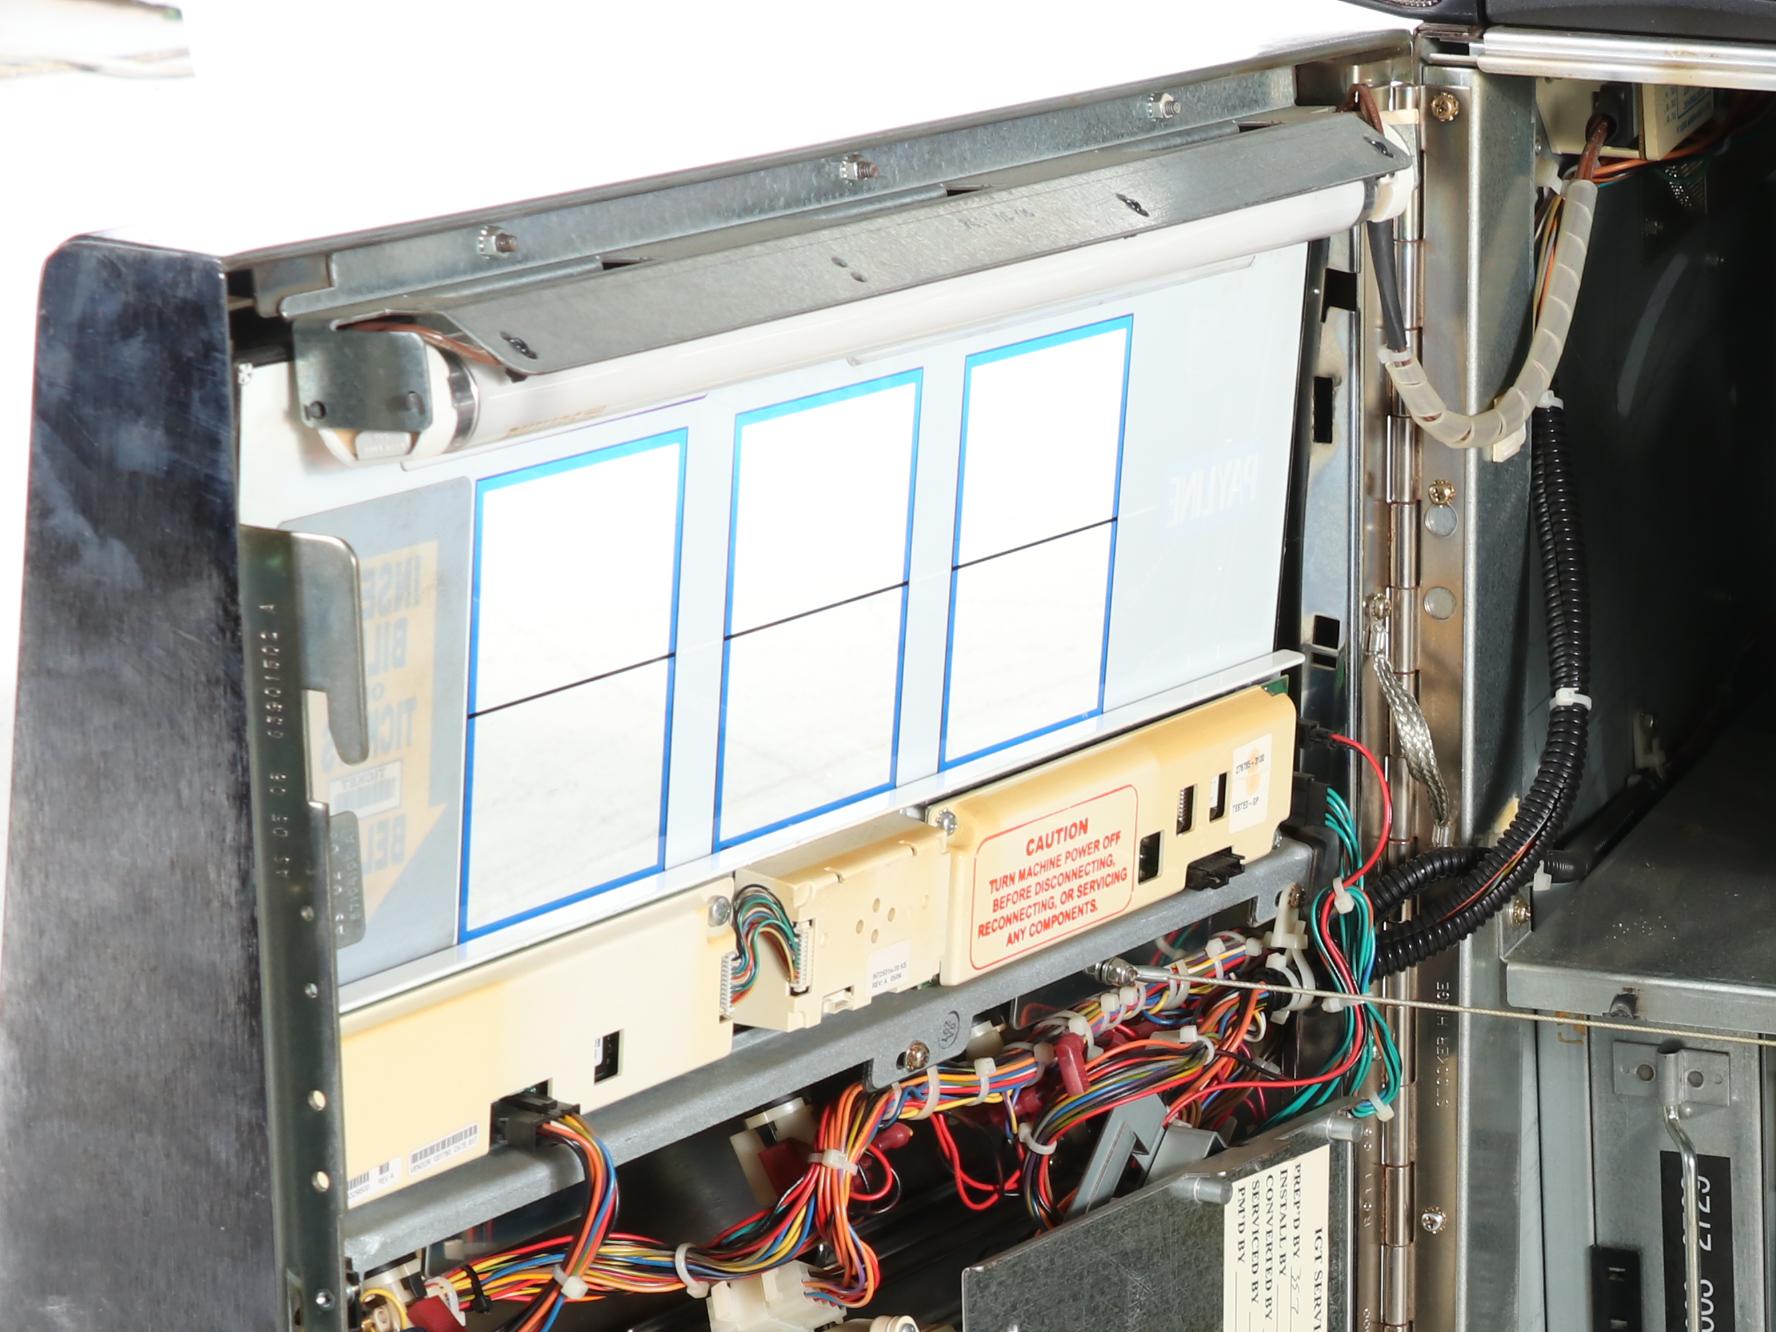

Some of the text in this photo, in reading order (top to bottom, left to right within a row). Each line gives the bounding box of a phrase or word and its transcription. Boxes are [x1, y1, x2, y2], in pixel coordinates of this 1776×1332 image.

[989, 831, 1120, 893] TURN MACHINE POWER OFF
[1026, 816, 1088, 856] CAUTION
[978, 865, 1127, 940] RECONNECTING, OR SERVICING
[993, 851, 1114, 912] BEFORE DISCONNECTING,
[1007, 896, 1097, 945] ANY COMPONENTS.
[1237, 1185, 1245, 1265] PM'D BY
[1250, 1178, 1259, 1306] SERVICED BY
[1264, 1173, 1273, 1322] CONVERTED BY
[1278, 1168, 1287, 1278] INSTALL BY
[1292, 1163, 1300, 1260] PREP'D BY
[1314, 1226, 1322, 1265] IGT
